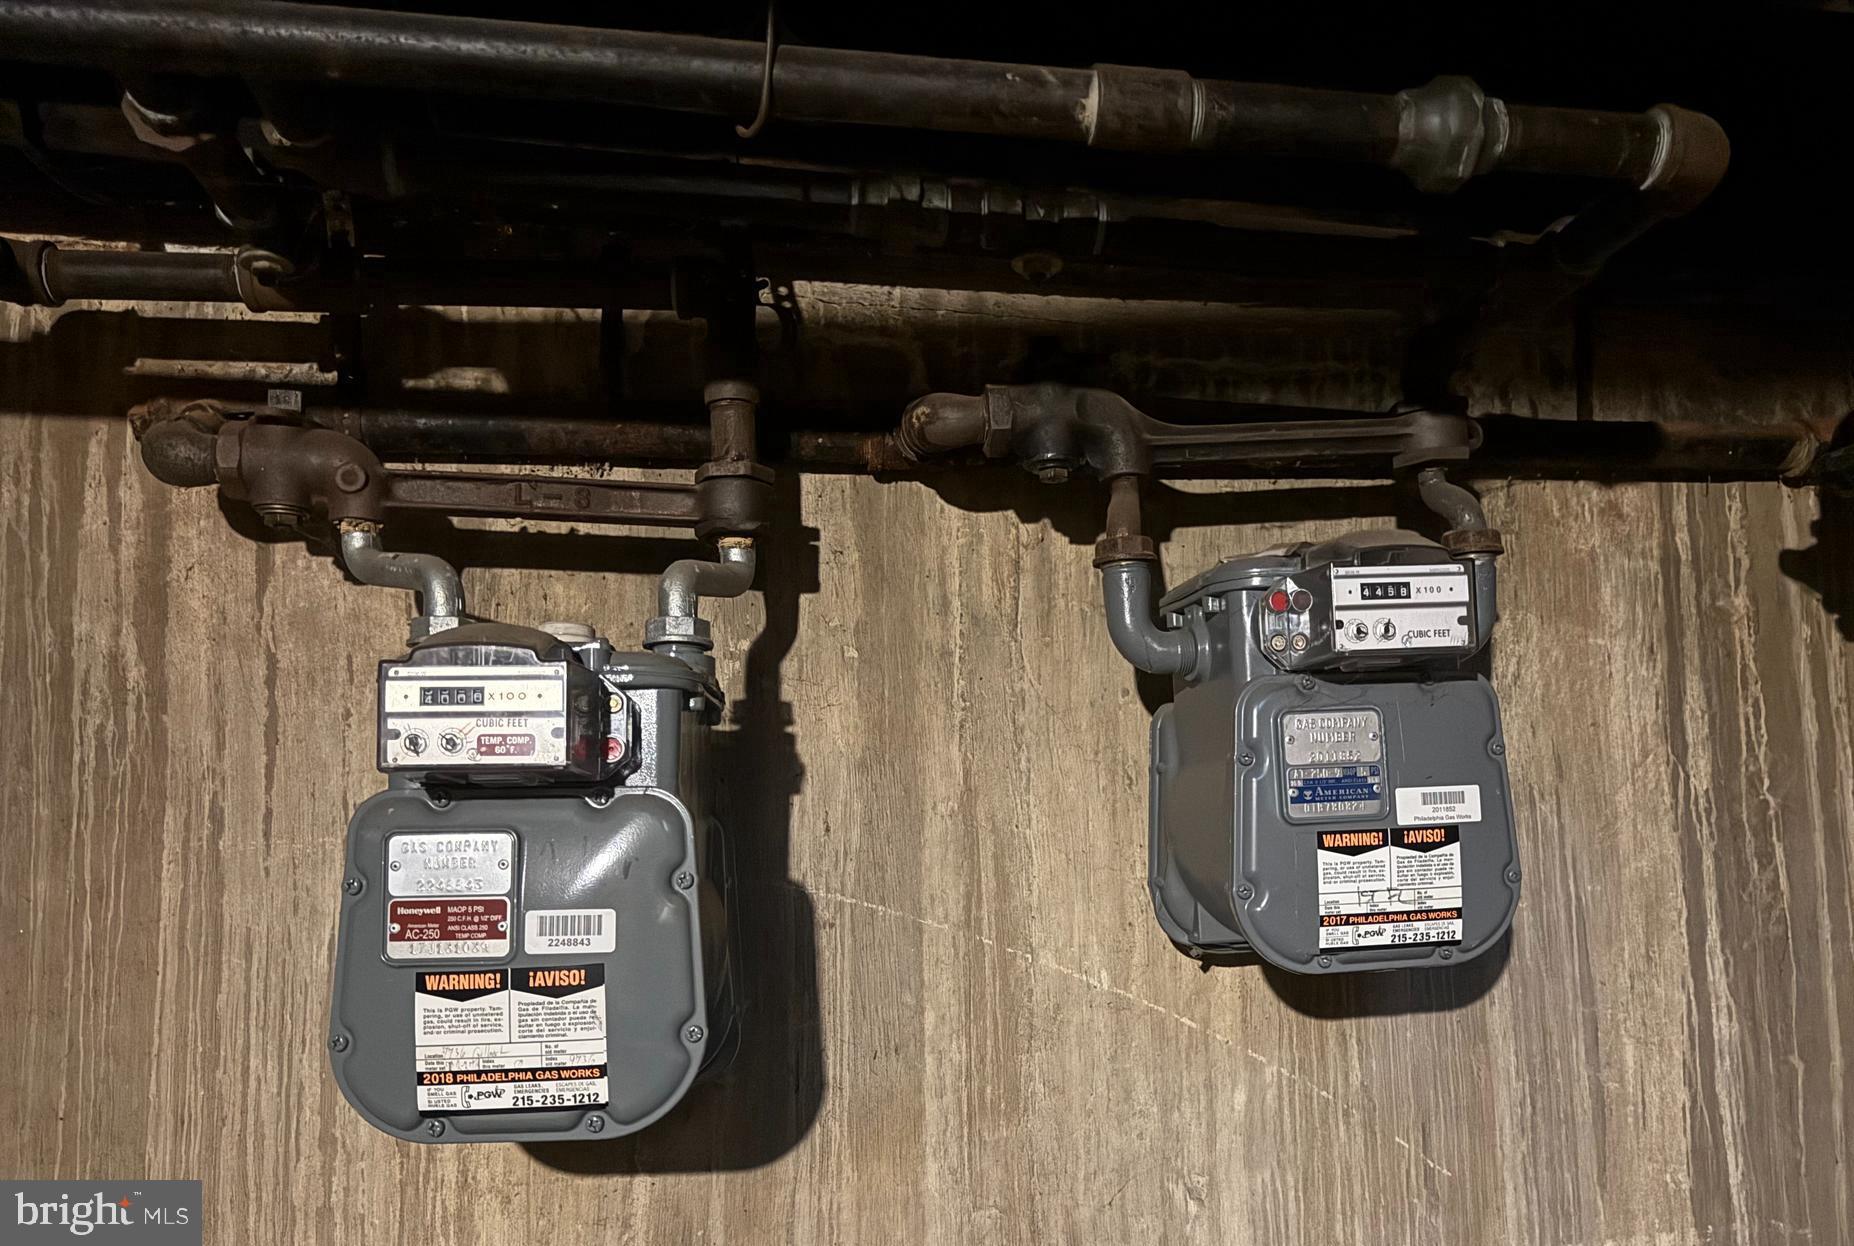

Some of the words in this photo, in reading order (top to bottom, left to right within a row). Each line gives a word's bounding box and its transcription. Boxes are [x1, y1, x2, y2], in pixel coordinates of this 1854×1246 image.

[1408, 630, 1431, 638] CUBIC
[1434, 629, 1451, 637] FEET
[475, 719, 504, 727] CUBIC
[507, 719, 529, 727] FEET
[480, 736, 503, 745] TEMP.
[506, 736, 532, 744] COMP.
[1315, 787, 1369, 796] AMERICAN
[1322, 832, 1383, 847] WARNING!
[1404, 829, 1445, 843] ¡AVISO!
[400, 842, 427, 854] GAS
[436, 840, 498, 853] COMPANY
[397, 907, 441, 916] Honeywell
[1323, 916, 1346, 925] 2017
[1349, 914, 1408, 923] PHILADELPHIA
[1410, 912, 1427, 920] GAS
[1428, 911, 1457, 919] WORKS
[405, 929, 440, 939] AC-250
[1391, 930, 1456, 943] 215-235-1212
[548, 938, 591, 947] 2248843
[424, 973, 501, 991] WARNING!
[529, 970, 586, 988] ¡AVISO!
[423, 1073, 453, 1084] 2018
[457, 1072, 532, 1082] PHILADELPHIA
[536, 1069, 558, 1079] GAS
[561, 1068, 600, 1078] WORKS
[512, 1092, 600, 1106] 215-235-1212
